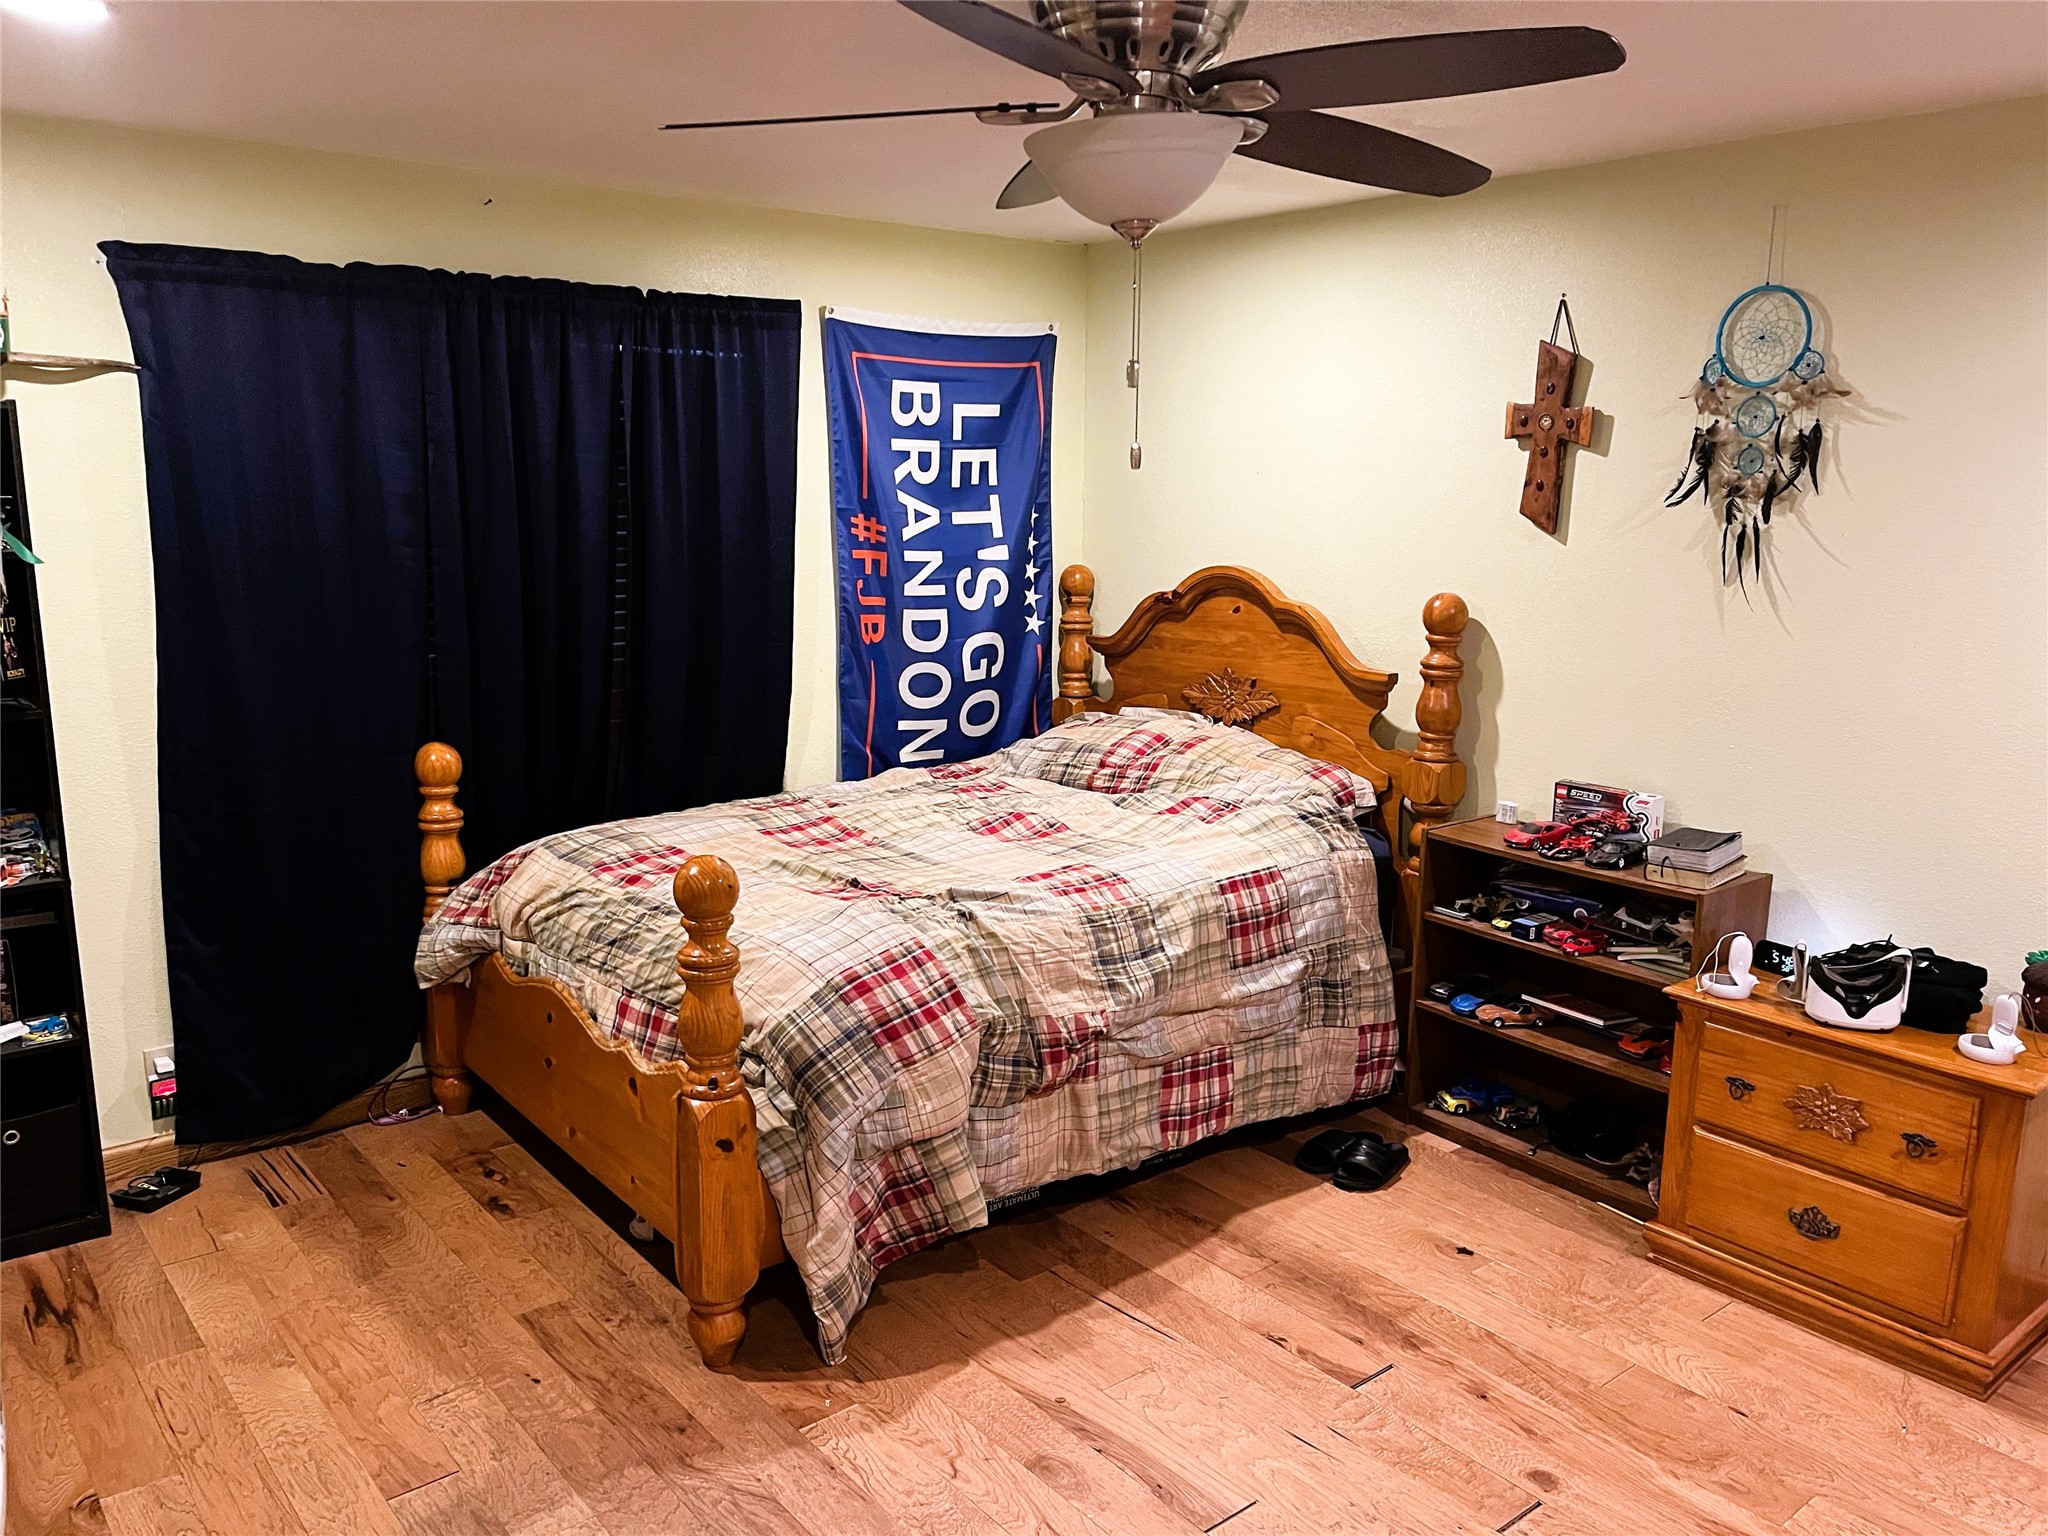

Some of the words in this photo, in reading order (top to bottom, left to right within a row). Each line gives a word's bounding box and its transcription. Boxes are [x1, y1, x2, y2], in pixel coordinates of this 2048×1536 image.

[951, 403, 1010, 611] LET'S
[850, 513, 887, 645] #FJB
[890, 379, 953, 764] BRANDON
[959, 631, 1005, 738] GO
[1570, 789, 1603, 802] SPEED
[989, 1202, 1003, 1212] ART
[1004, 1190, 1040, 1207] ULTIMATE
